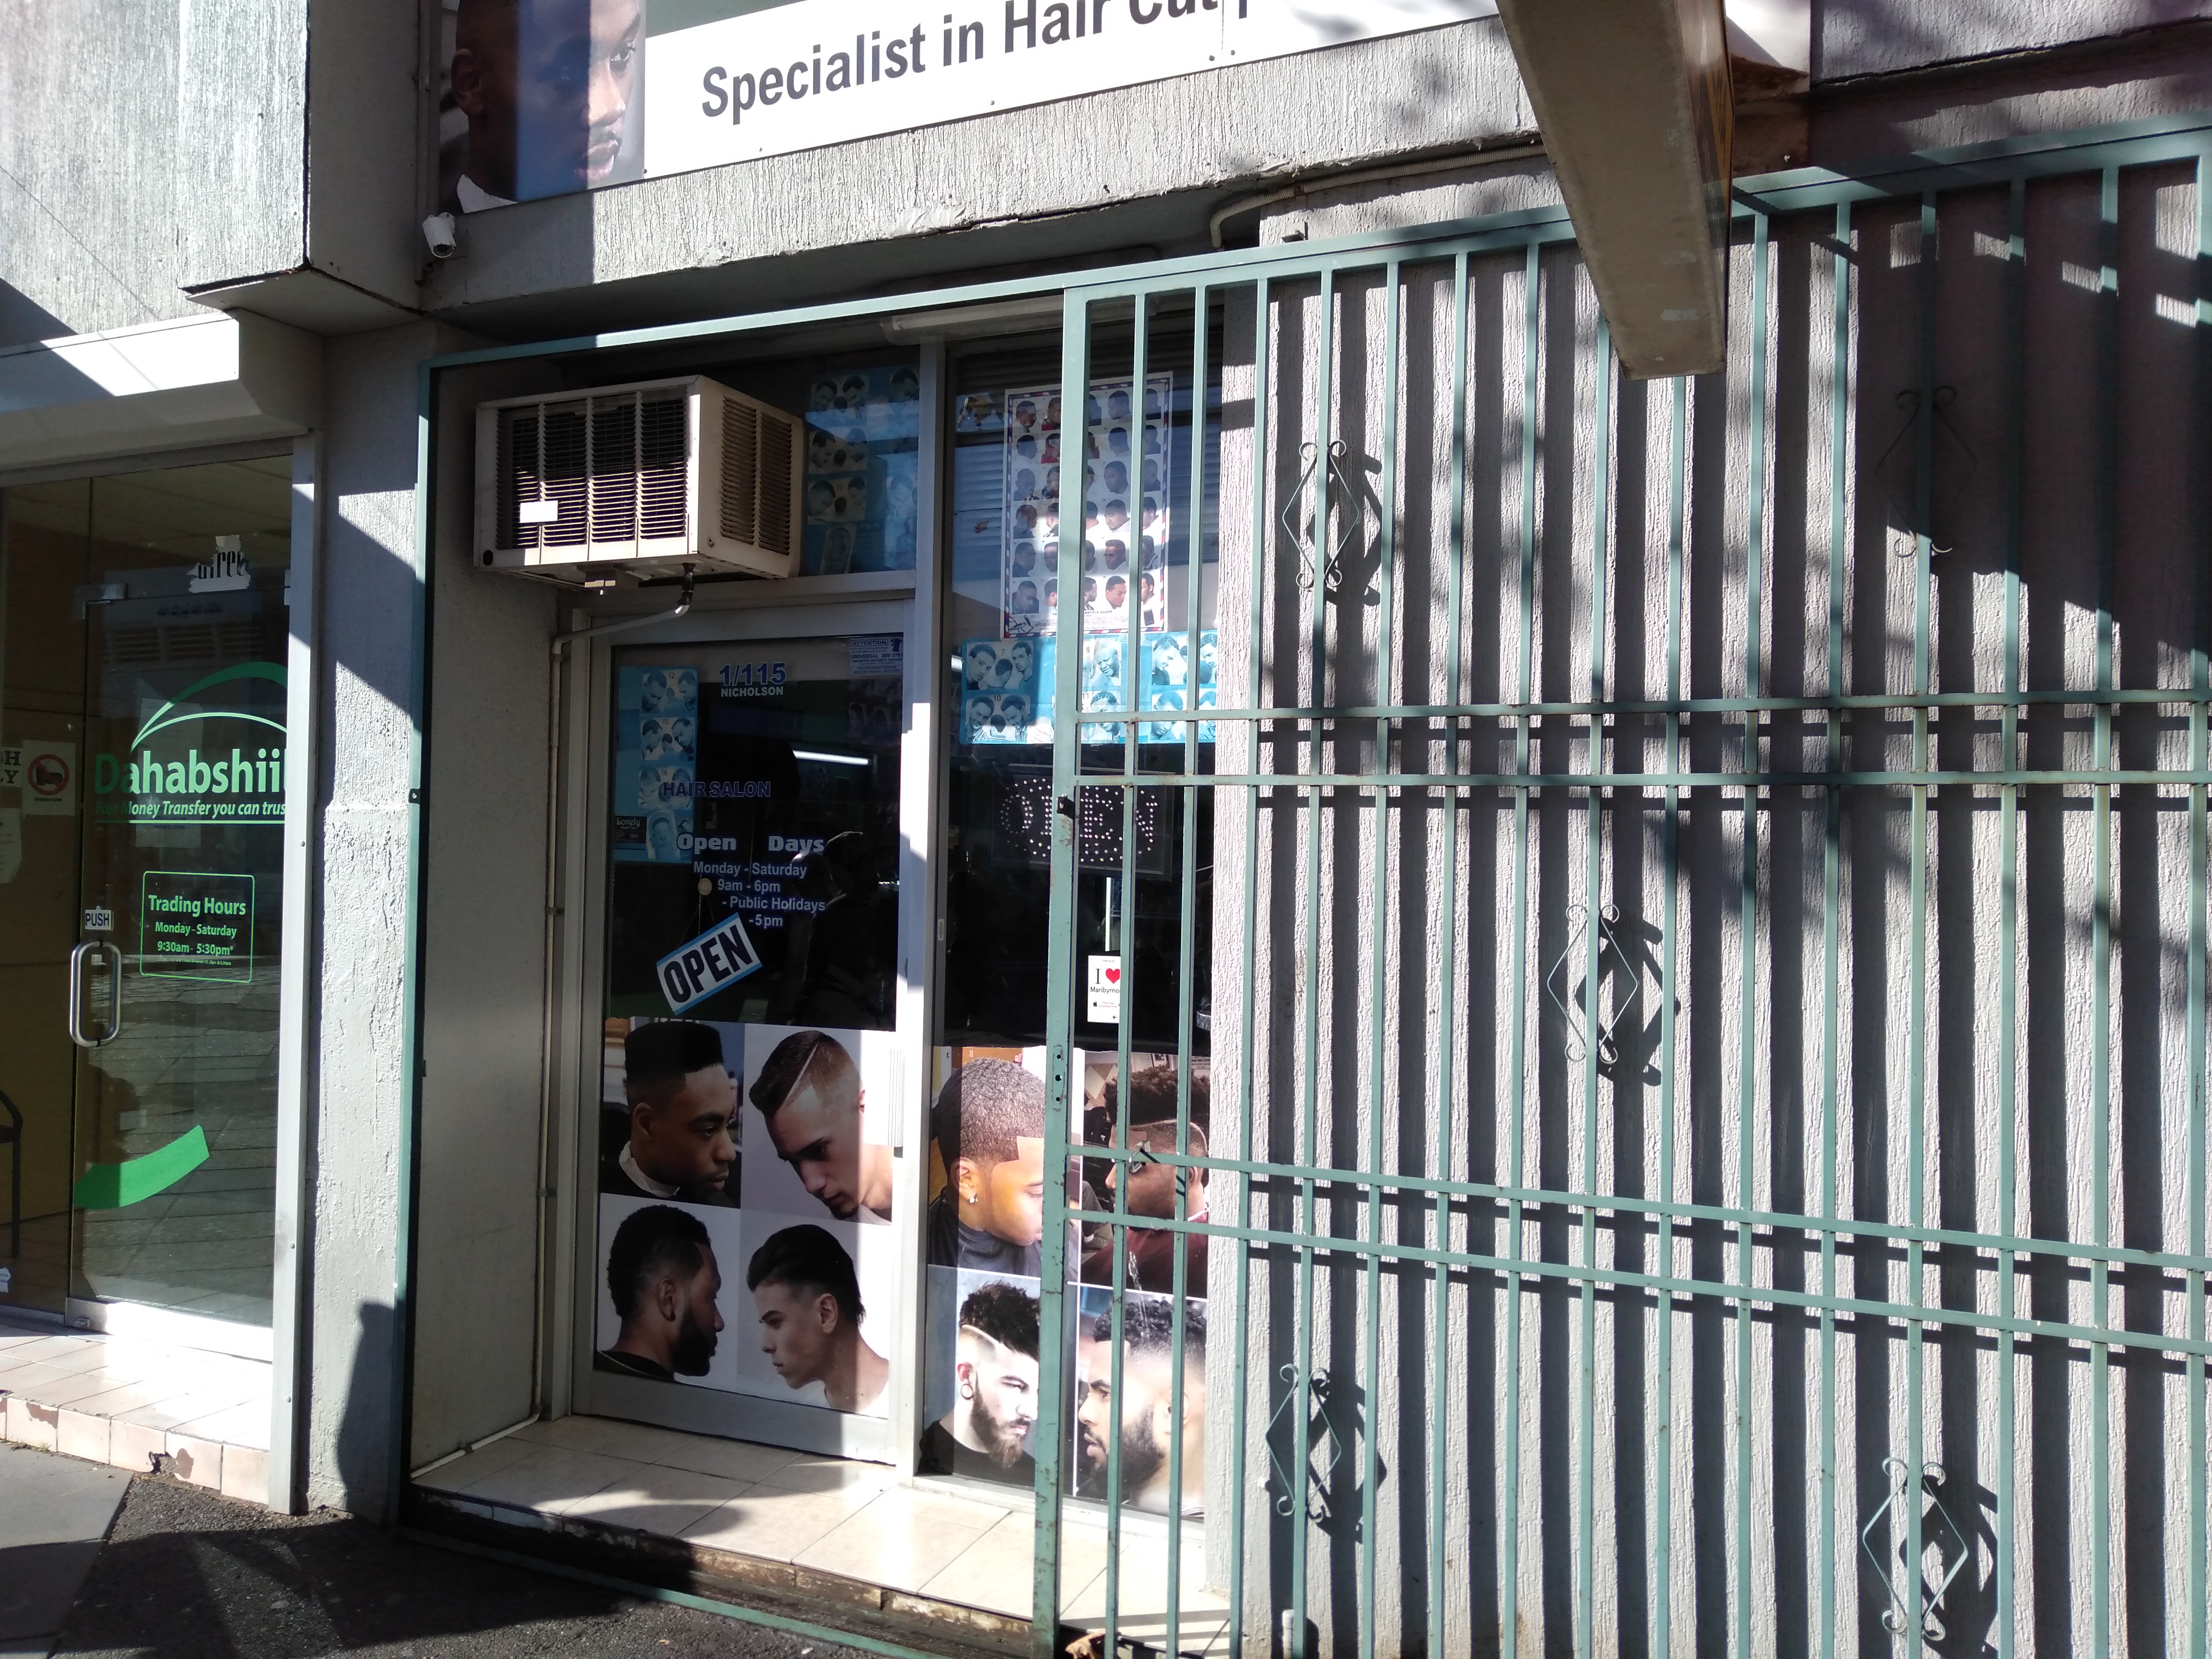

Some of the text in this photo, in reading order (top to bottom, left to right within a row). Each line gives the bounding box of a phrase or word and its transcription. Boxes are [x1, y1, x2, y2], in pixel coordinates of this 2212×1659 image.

[702, 22, 926, 126] Specialist
[943, 13, 984, 67] in
[1004, 0, 1111, 54] Hair
[719, 662, 786, 686] 1/115
[720, 686, 784, 698] NICHOLSON
[95, 748, 286, 794] Dahabshii
[663, 781, 772, 798] HAIR SALON
[123, 801, 160, 819] Money
[163, 799, 213, 815] Transfer
[213, 803, 237, 819] you
[238, 803, 260, 815] can
[262, 802, 286, 815] trus
[676, 832, 825, 855] Open Days
[693, 861, 741, 877] Monday
[752, 862, 807, 878] Saturday
[717, 878, 743, 891] 9am
[754, 879, 781, 894] 6pm
[148, 894, 247, 917] Trading Hours
[730, 895, 768, 909] Public
[772, 896, 826, 914] Holidays
[86, 912, 110, 927] PUSH
[664, 924, 753, 1003] OPEN
[1095, 968, 1101, 984] I
